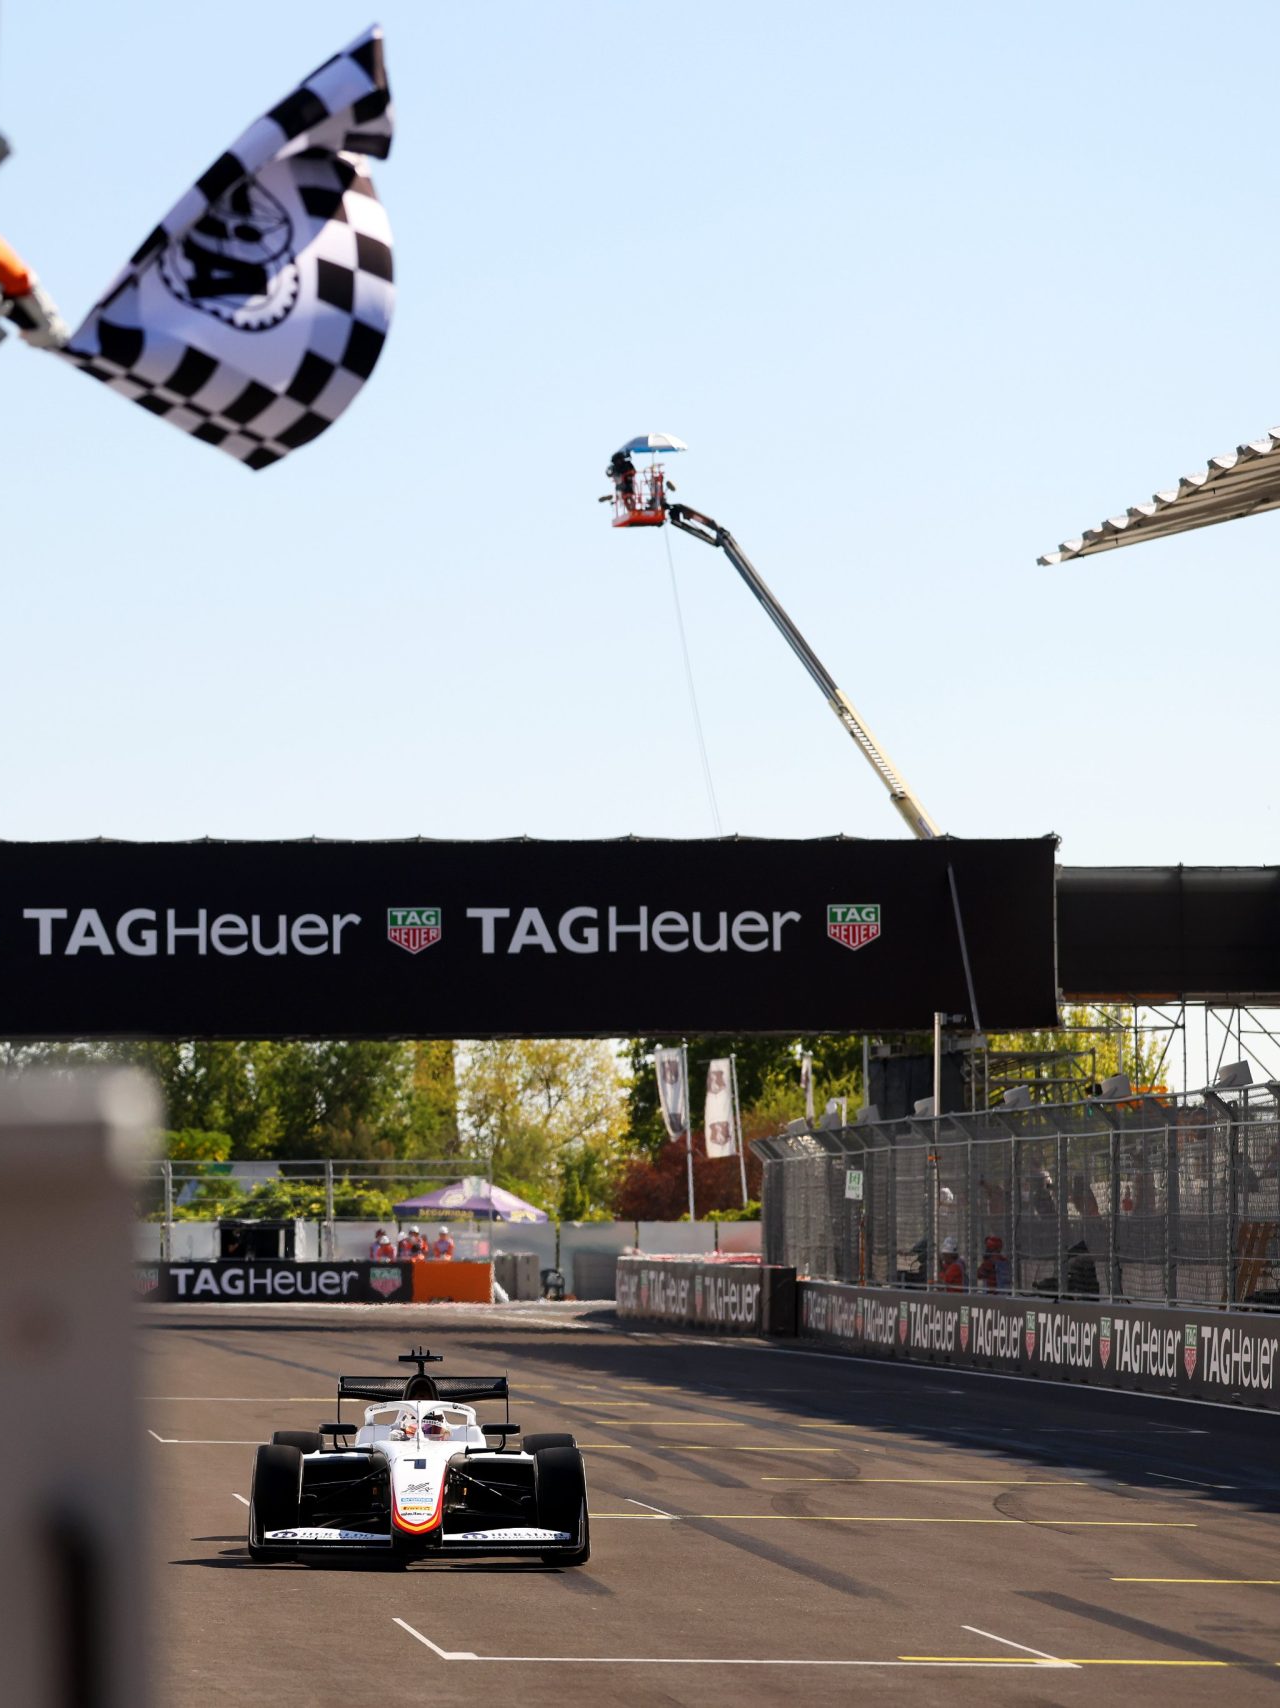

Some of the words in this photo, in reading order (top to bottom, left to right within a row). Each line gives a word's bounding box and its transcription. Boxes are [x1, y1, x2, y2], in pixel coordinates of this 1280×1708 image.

[392, 910, 436, 925] TAG
[831, 907, 876, 922] TAG
[391, 929, 437, 950] HEUER
[830, 925, 878, 947] HEUER
[1185, 1327, 1197, 1347] TAG
